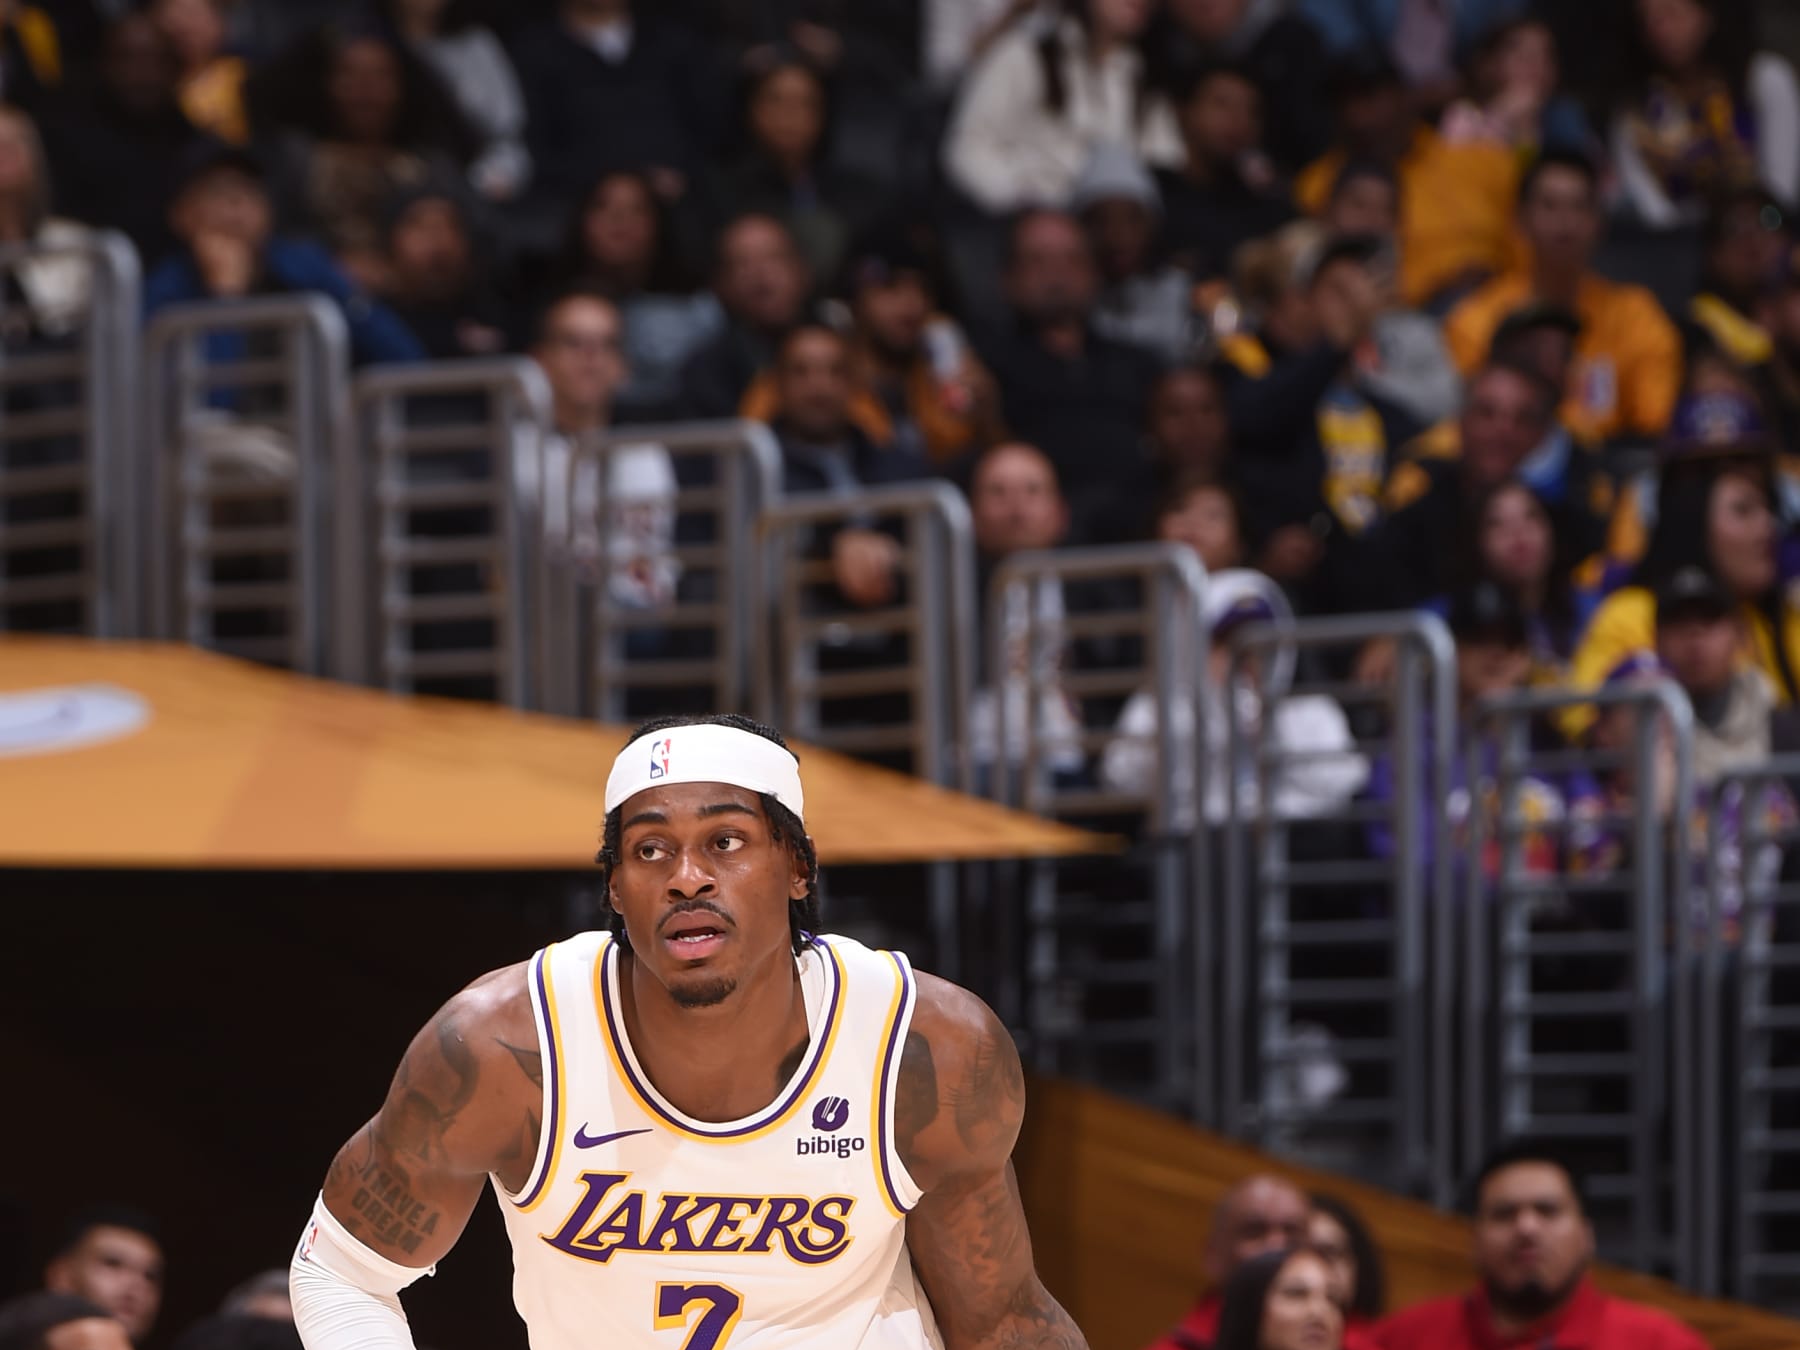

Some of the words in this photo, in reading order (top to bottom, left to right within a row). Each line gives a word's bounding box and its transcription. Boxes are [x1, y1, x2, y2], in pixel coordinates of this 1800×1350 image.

[797, 1135, 865, 1159] bibigo
[352, 1188, 424, 1255] DREAM
[371, 1172, 426, 1227] HAVE
[422, 1212, 440, 1235] A
[538, 1170, 858, 1267] LAKERS
